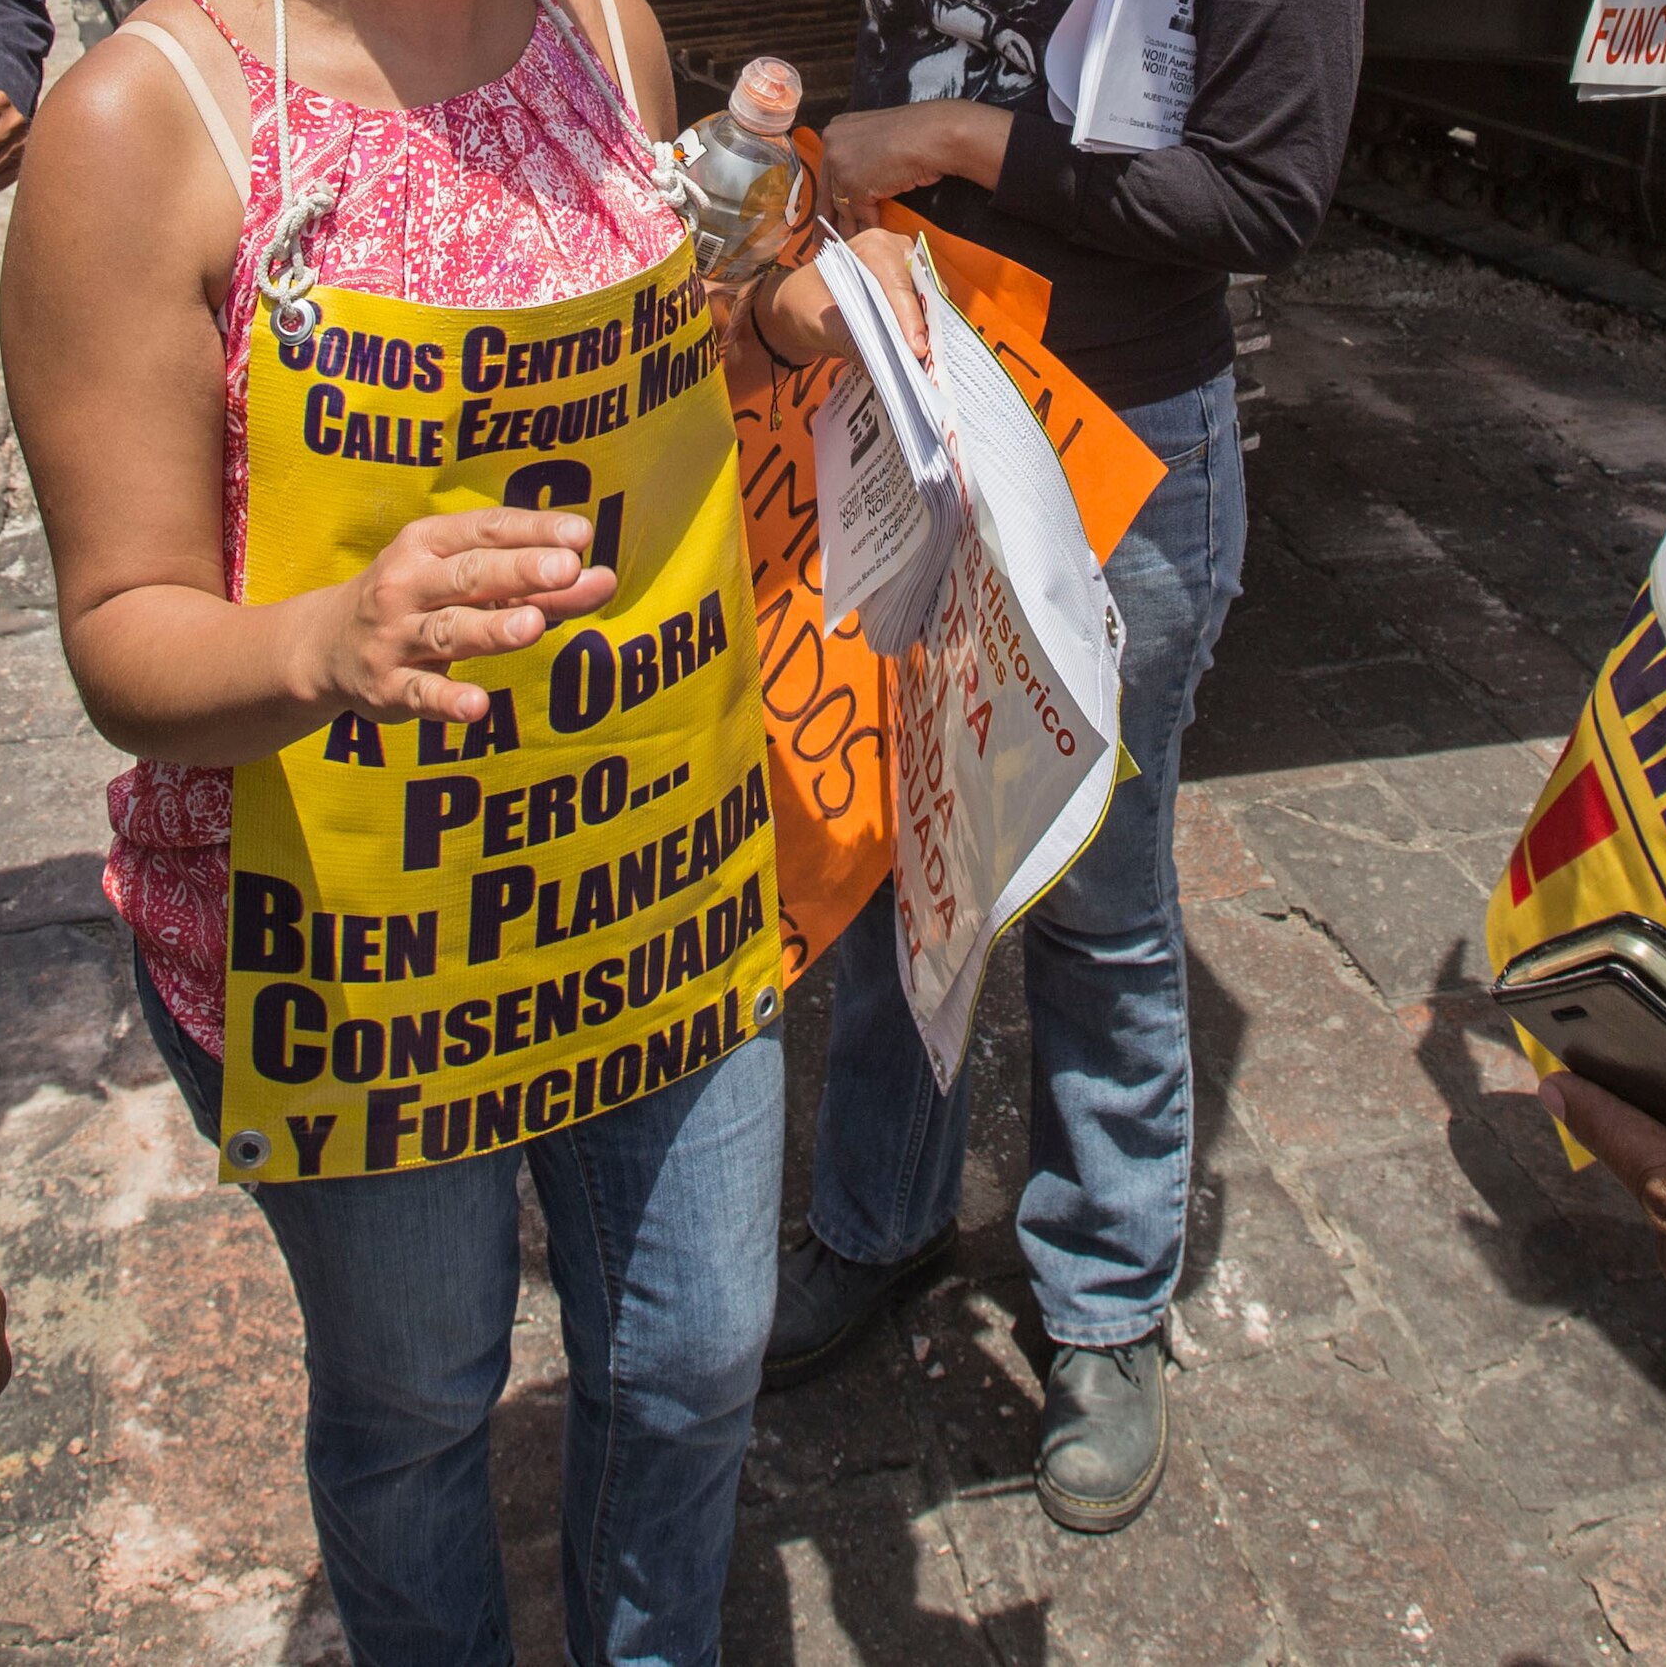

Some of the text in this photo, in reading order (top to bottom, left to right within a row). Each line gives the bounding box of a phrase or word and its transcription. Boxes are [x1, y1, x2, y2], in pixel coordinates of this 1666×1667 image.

[278, 299, 446, 394] SOMOS
[461, 319, 623, 394] CENTRO
[303, 383, 446, 467] CALLE
[456, 384, 630, 462] EZEQUIEL
[839, 493, 860, 523] NO!!!
[842, 505, 863, 534] NO!!!
[323, 588, 730, 768] A LA OBRA
[982, 566, 1077, 758] Historico
[231, 870, 438, 983] BIEN
[467, 763, 771, 967] PLANEADA
[402, 755, 690, 872] PERO...
[895, 689, 957, 941] SUADA
[251, 871, 765, 1085] CONSENSUADA
[285, 985, 747, 1177] Y FUNCIONAL
